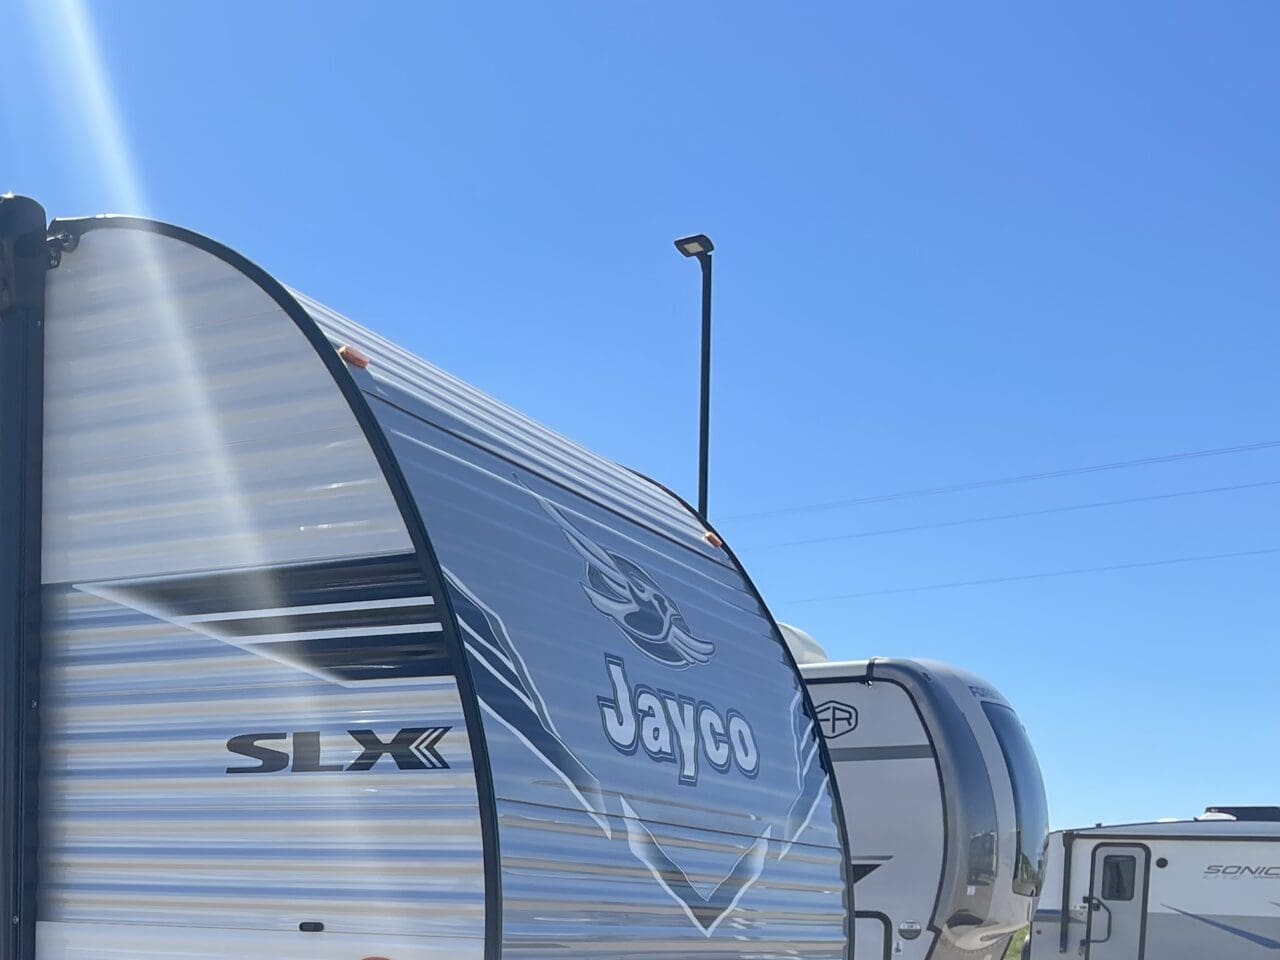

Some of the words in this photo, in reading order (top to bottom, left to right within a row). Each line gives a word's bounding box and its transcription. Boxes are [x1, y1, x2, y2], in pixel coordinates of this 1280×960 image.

[597, 652, 760, 787] Jayco
[226, 726, 453, 773] SLX
[1204, 865, 1280, 876] SONIC
